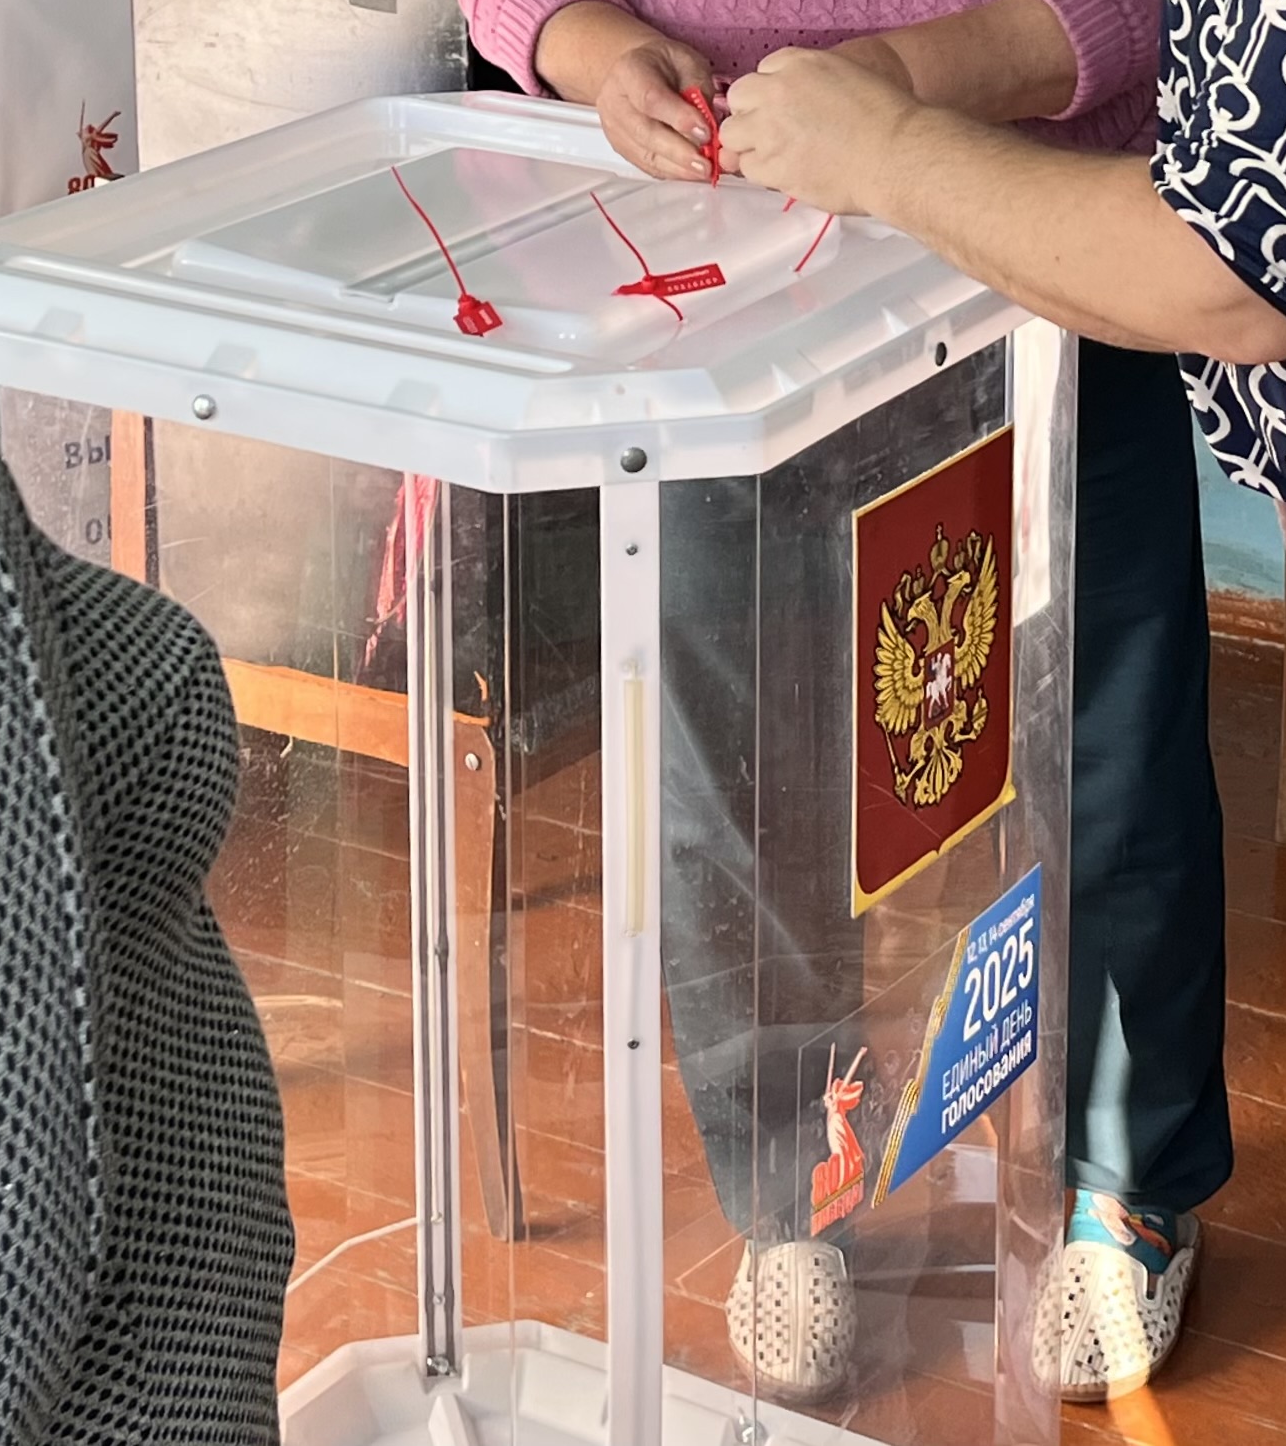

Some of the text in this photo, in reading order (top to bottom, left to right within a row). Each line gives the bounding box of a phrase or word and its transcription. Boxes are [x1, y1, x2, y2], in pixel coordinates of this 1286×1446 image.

[963, 917, 1034, 1042] 2025
[943, 998, 1033, 1100] ЕДИНЫЙ ДЕНЬ
